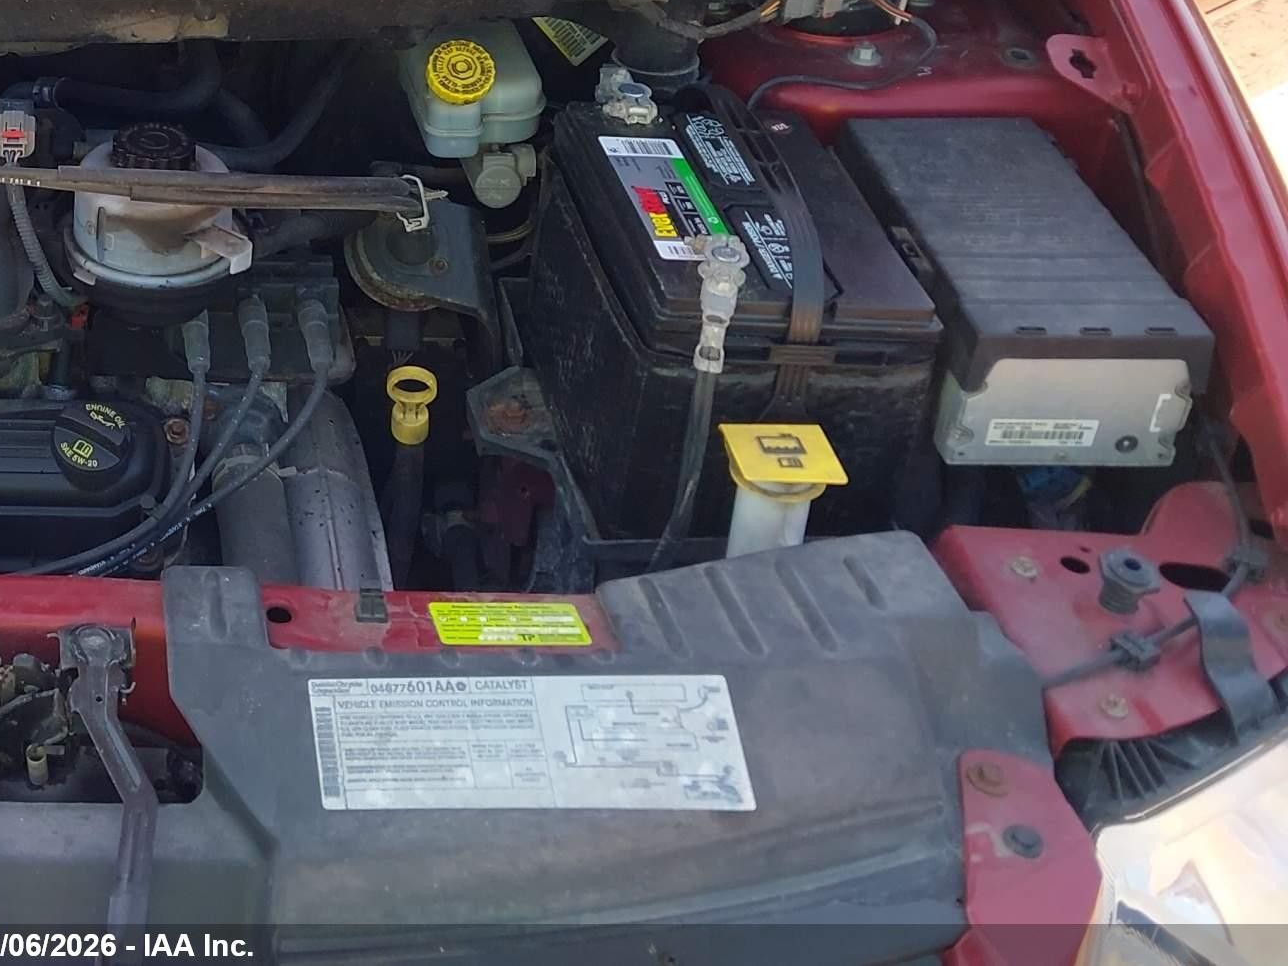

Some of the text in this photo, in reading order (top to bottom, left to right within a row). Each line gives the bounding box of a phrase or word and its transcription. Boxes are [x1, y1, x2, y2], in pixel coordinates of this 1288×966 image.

[60, 442, 98, 468] SAE 5W-20
[475, 680, 528, 690] CATALYST
[338, 698, 534, 709] VEHICLE EMISSION CONTROL INFORMATION
